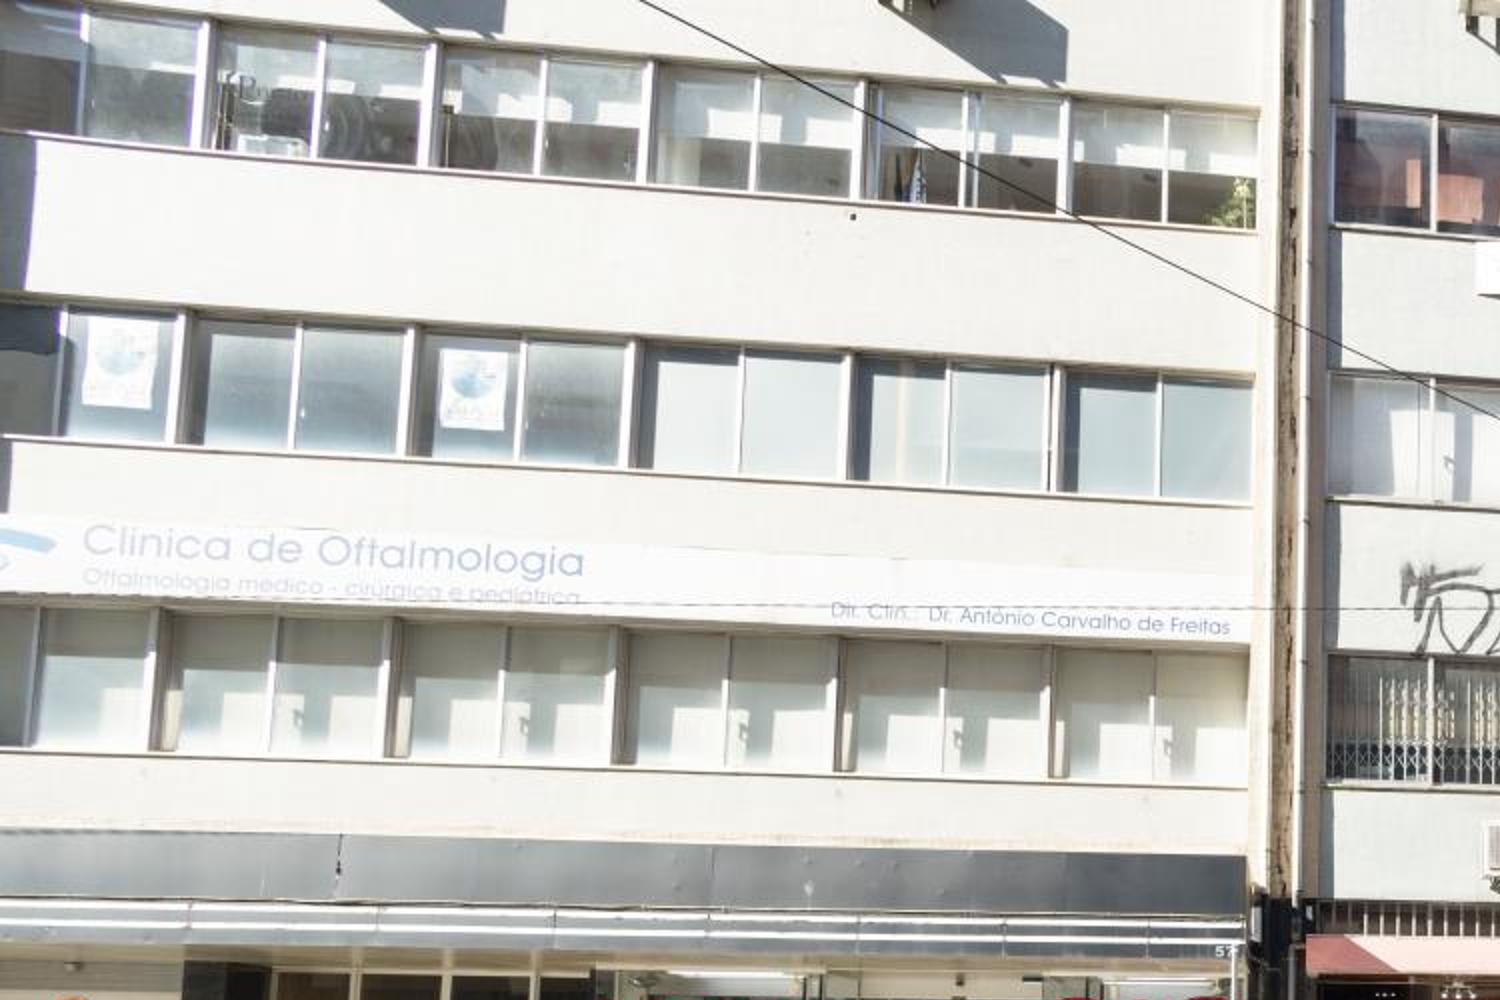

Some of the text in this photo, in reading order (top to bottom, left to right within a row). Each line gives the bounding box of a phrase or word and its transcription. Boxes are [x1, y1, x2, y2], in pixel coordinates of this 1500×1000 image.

[248, 531, 303, 563] de
[318, 534, 584, 582] Oftalmologia
[1041, 611, 1132, 631] Carvalho
[1137, 615, 1164, 632] de
[1170, 616, 1232, 636] Freitas
